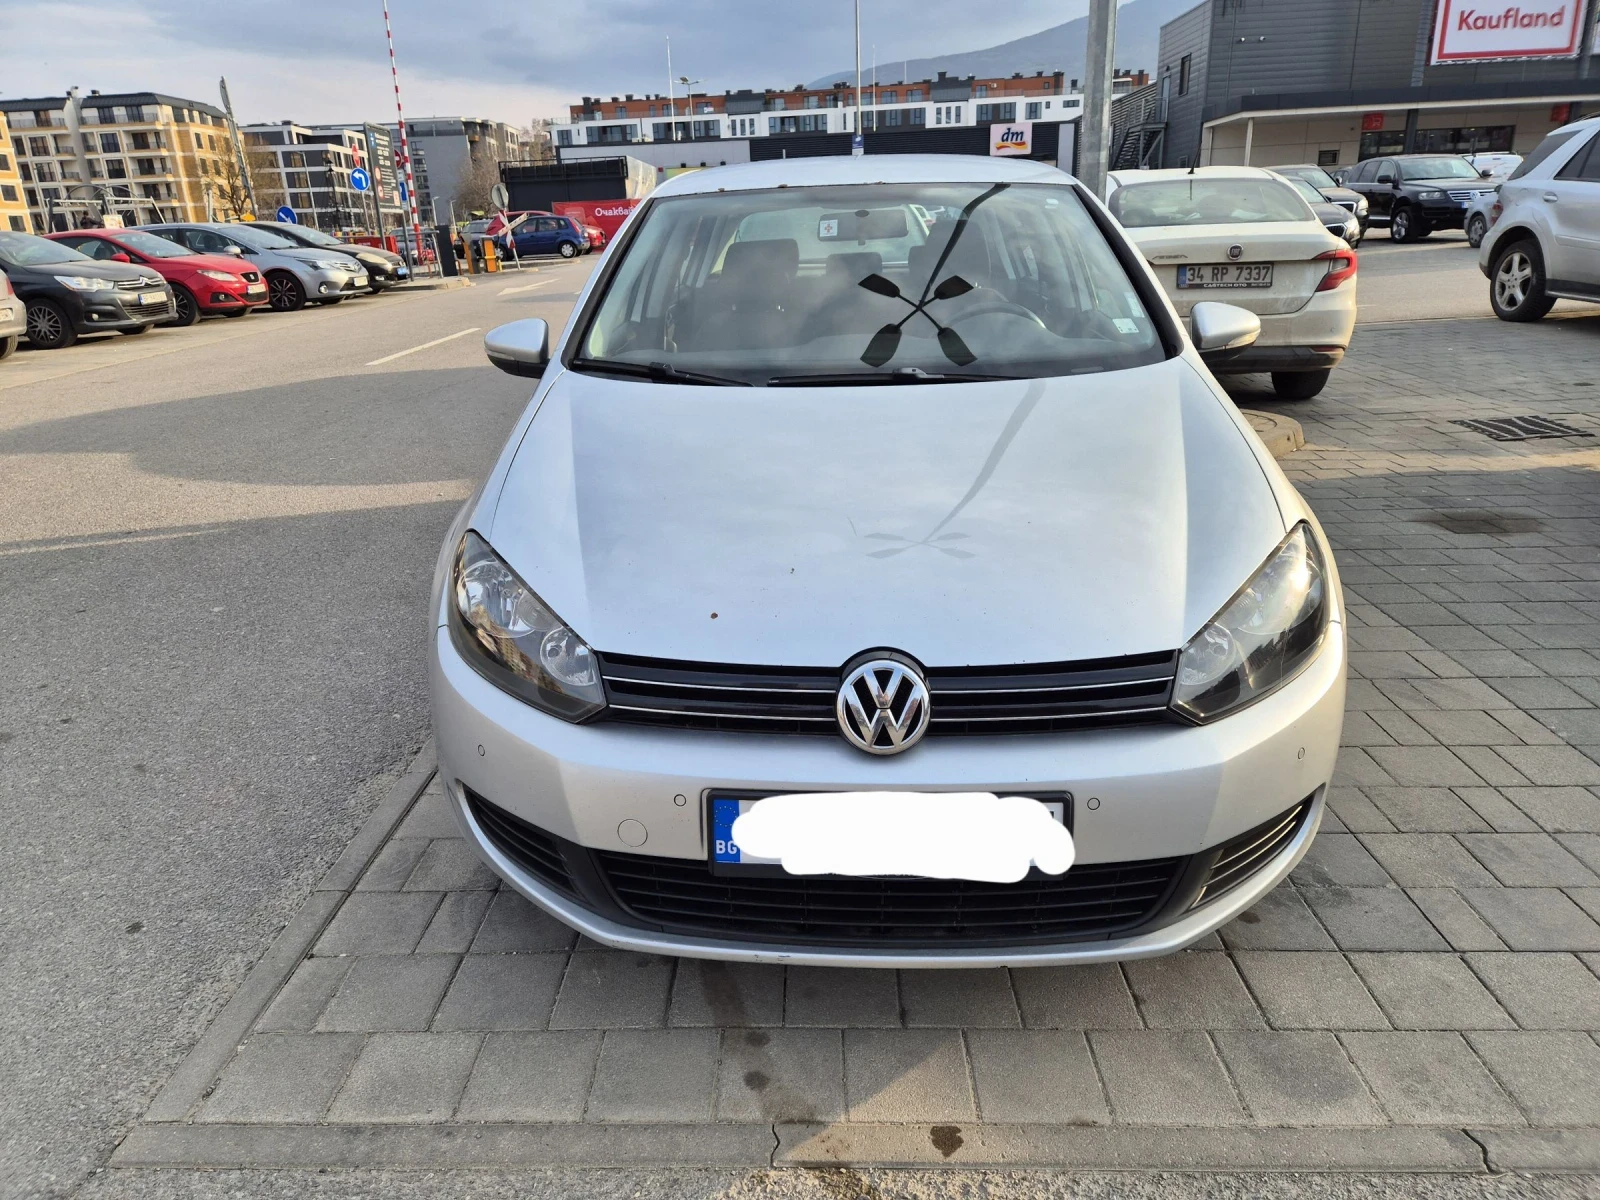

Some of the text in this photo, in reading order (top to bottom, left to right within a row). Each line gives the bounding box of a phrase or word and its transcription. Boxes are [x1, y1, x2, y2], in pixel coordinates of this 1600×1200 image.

[1458, 5, 1566, 31] Kaufland
[1001, 127, 1024, 143] dm
[1187, 265, 1271, 282] 34 RP 7337
[715, 839, 738, 855] BG
